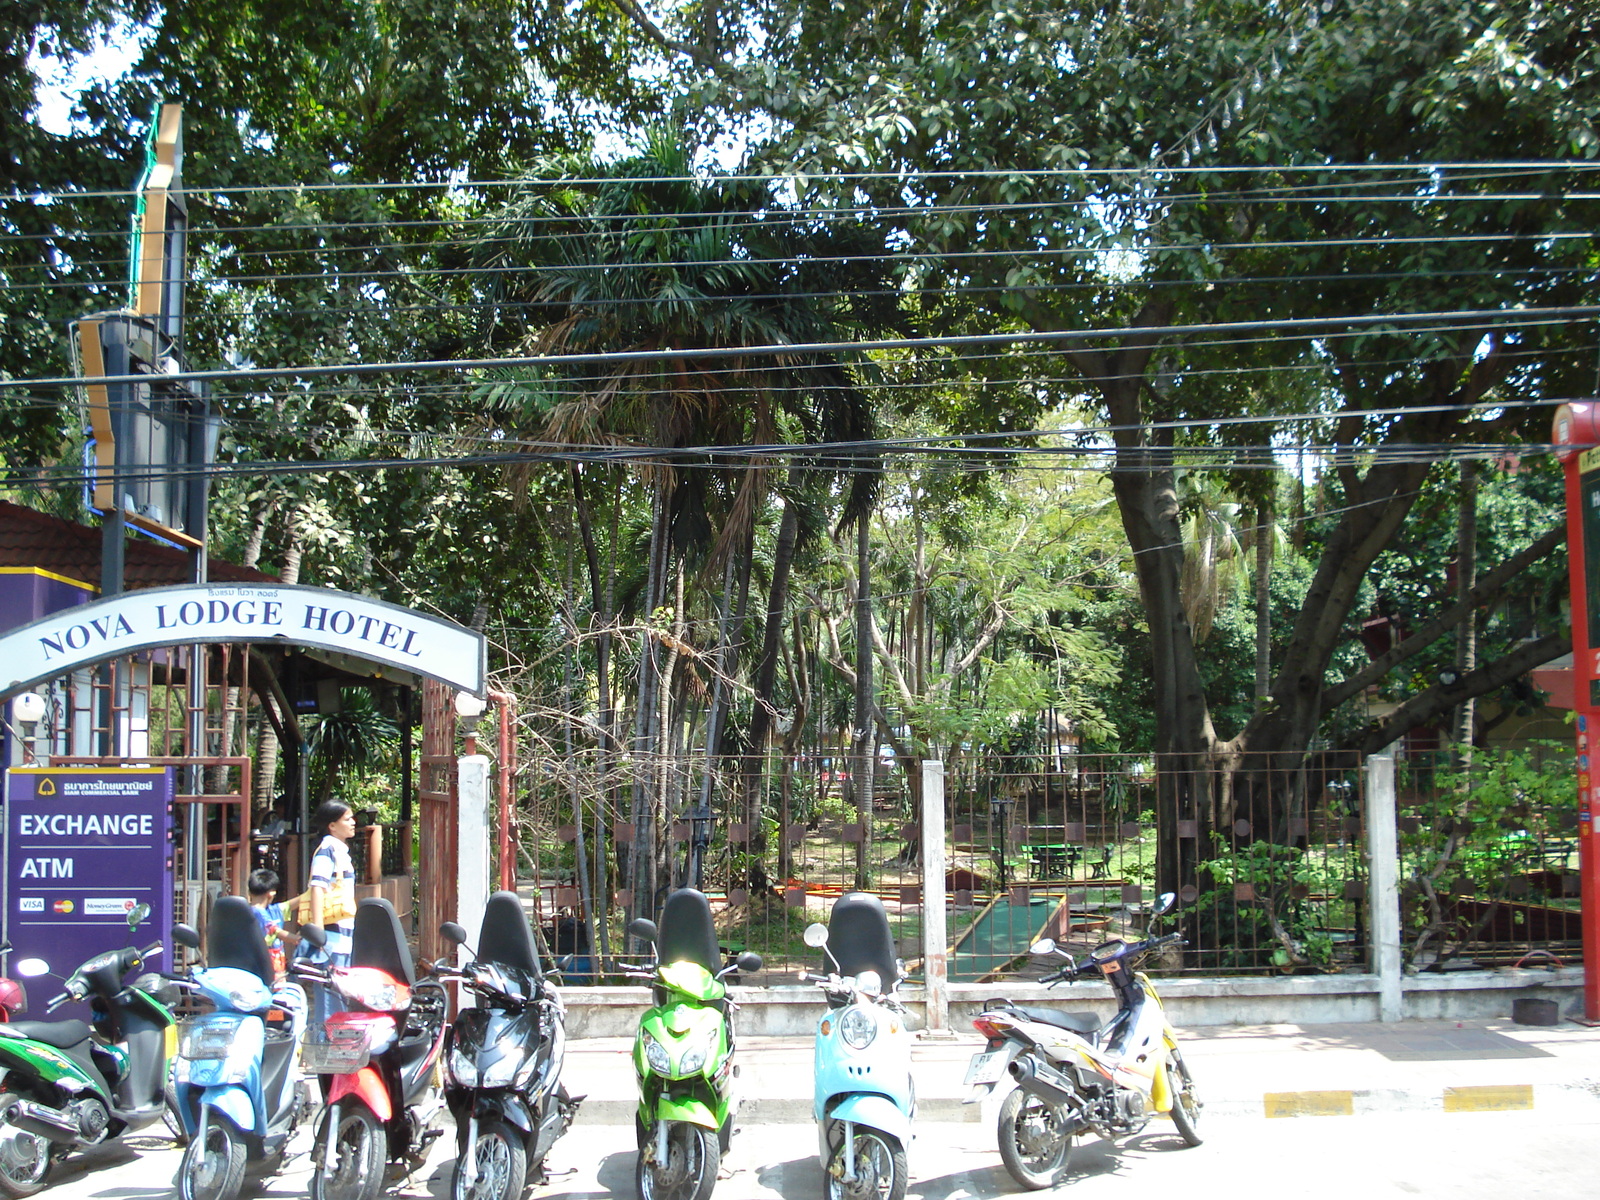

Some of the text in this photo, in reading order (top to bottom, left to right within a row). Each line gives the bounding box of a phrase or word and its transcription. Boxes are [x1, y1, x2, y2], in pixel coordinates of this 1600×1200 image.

[39, 600, 423, 661] NOVA LODGE HOTEL
[64, 780, 153, 791] ธนาคารไทยพาณิชย์
[20, 814, 153, 836] EXCHANGE
[20, 858, 73, 878] ATM
[23, 901, 43, 909] VISA
